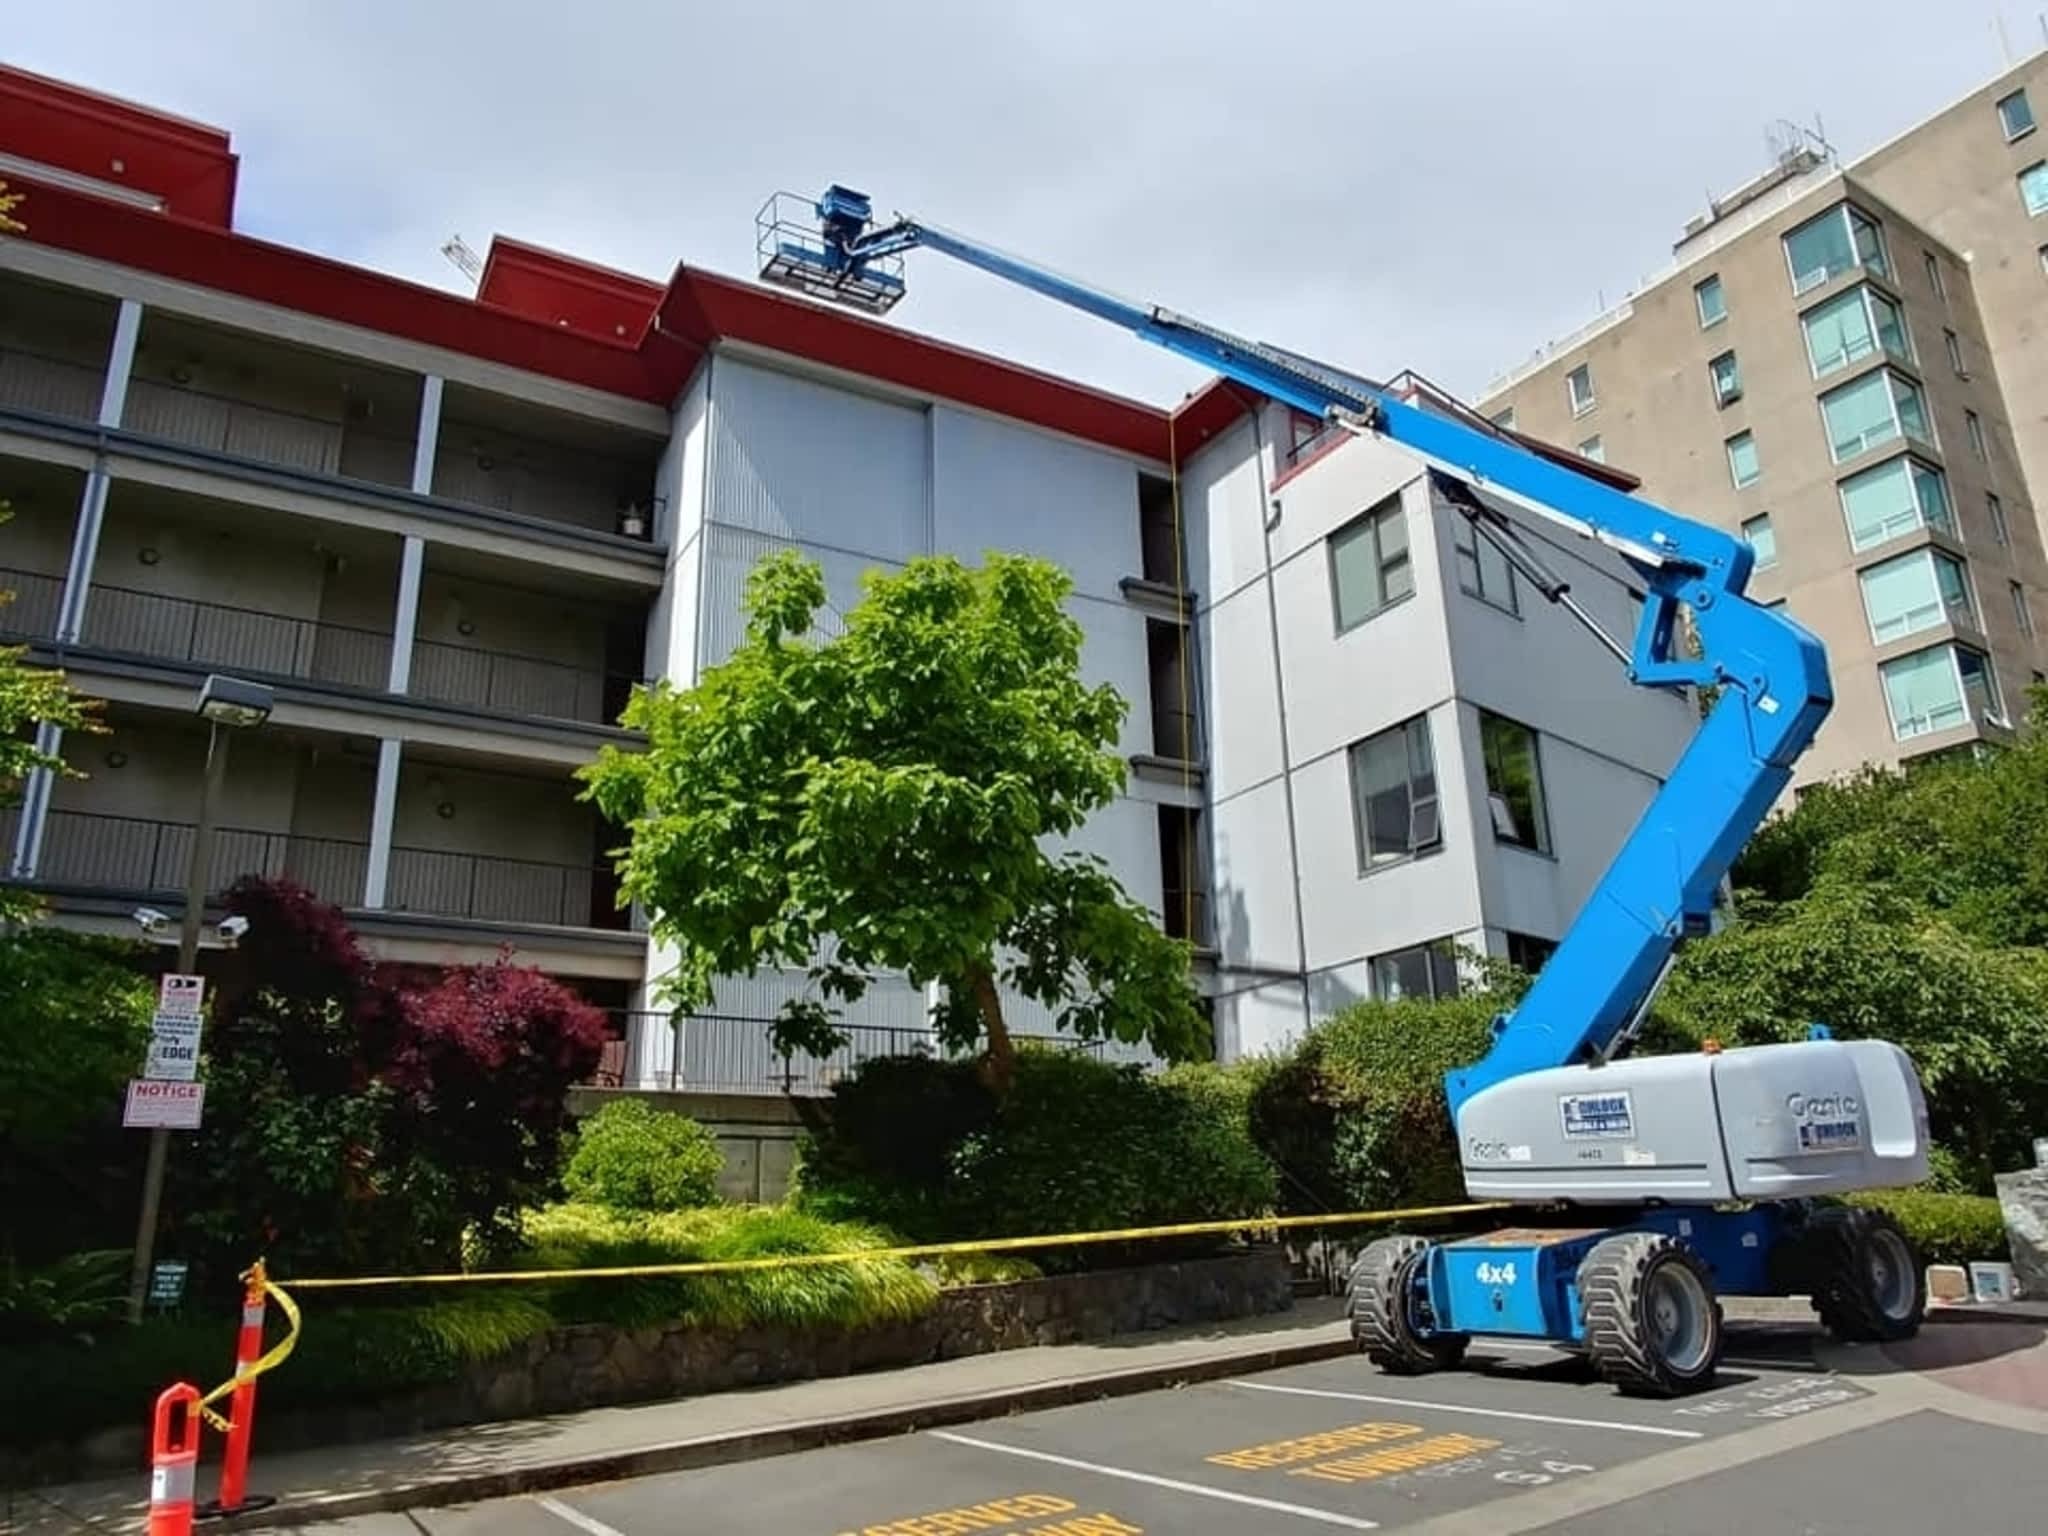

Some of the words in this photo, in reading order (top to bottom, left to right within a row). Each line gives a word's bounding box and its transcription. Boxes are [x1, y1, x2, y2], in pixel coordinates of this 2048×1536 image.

[162, 1047, 194, 1060] EDGE
[136, 1084, 198, 1099] NOTICE
[1475, 1261, 1517, 1286] 4x4
[1203, 1421, 1425, 1470] RESERVED
